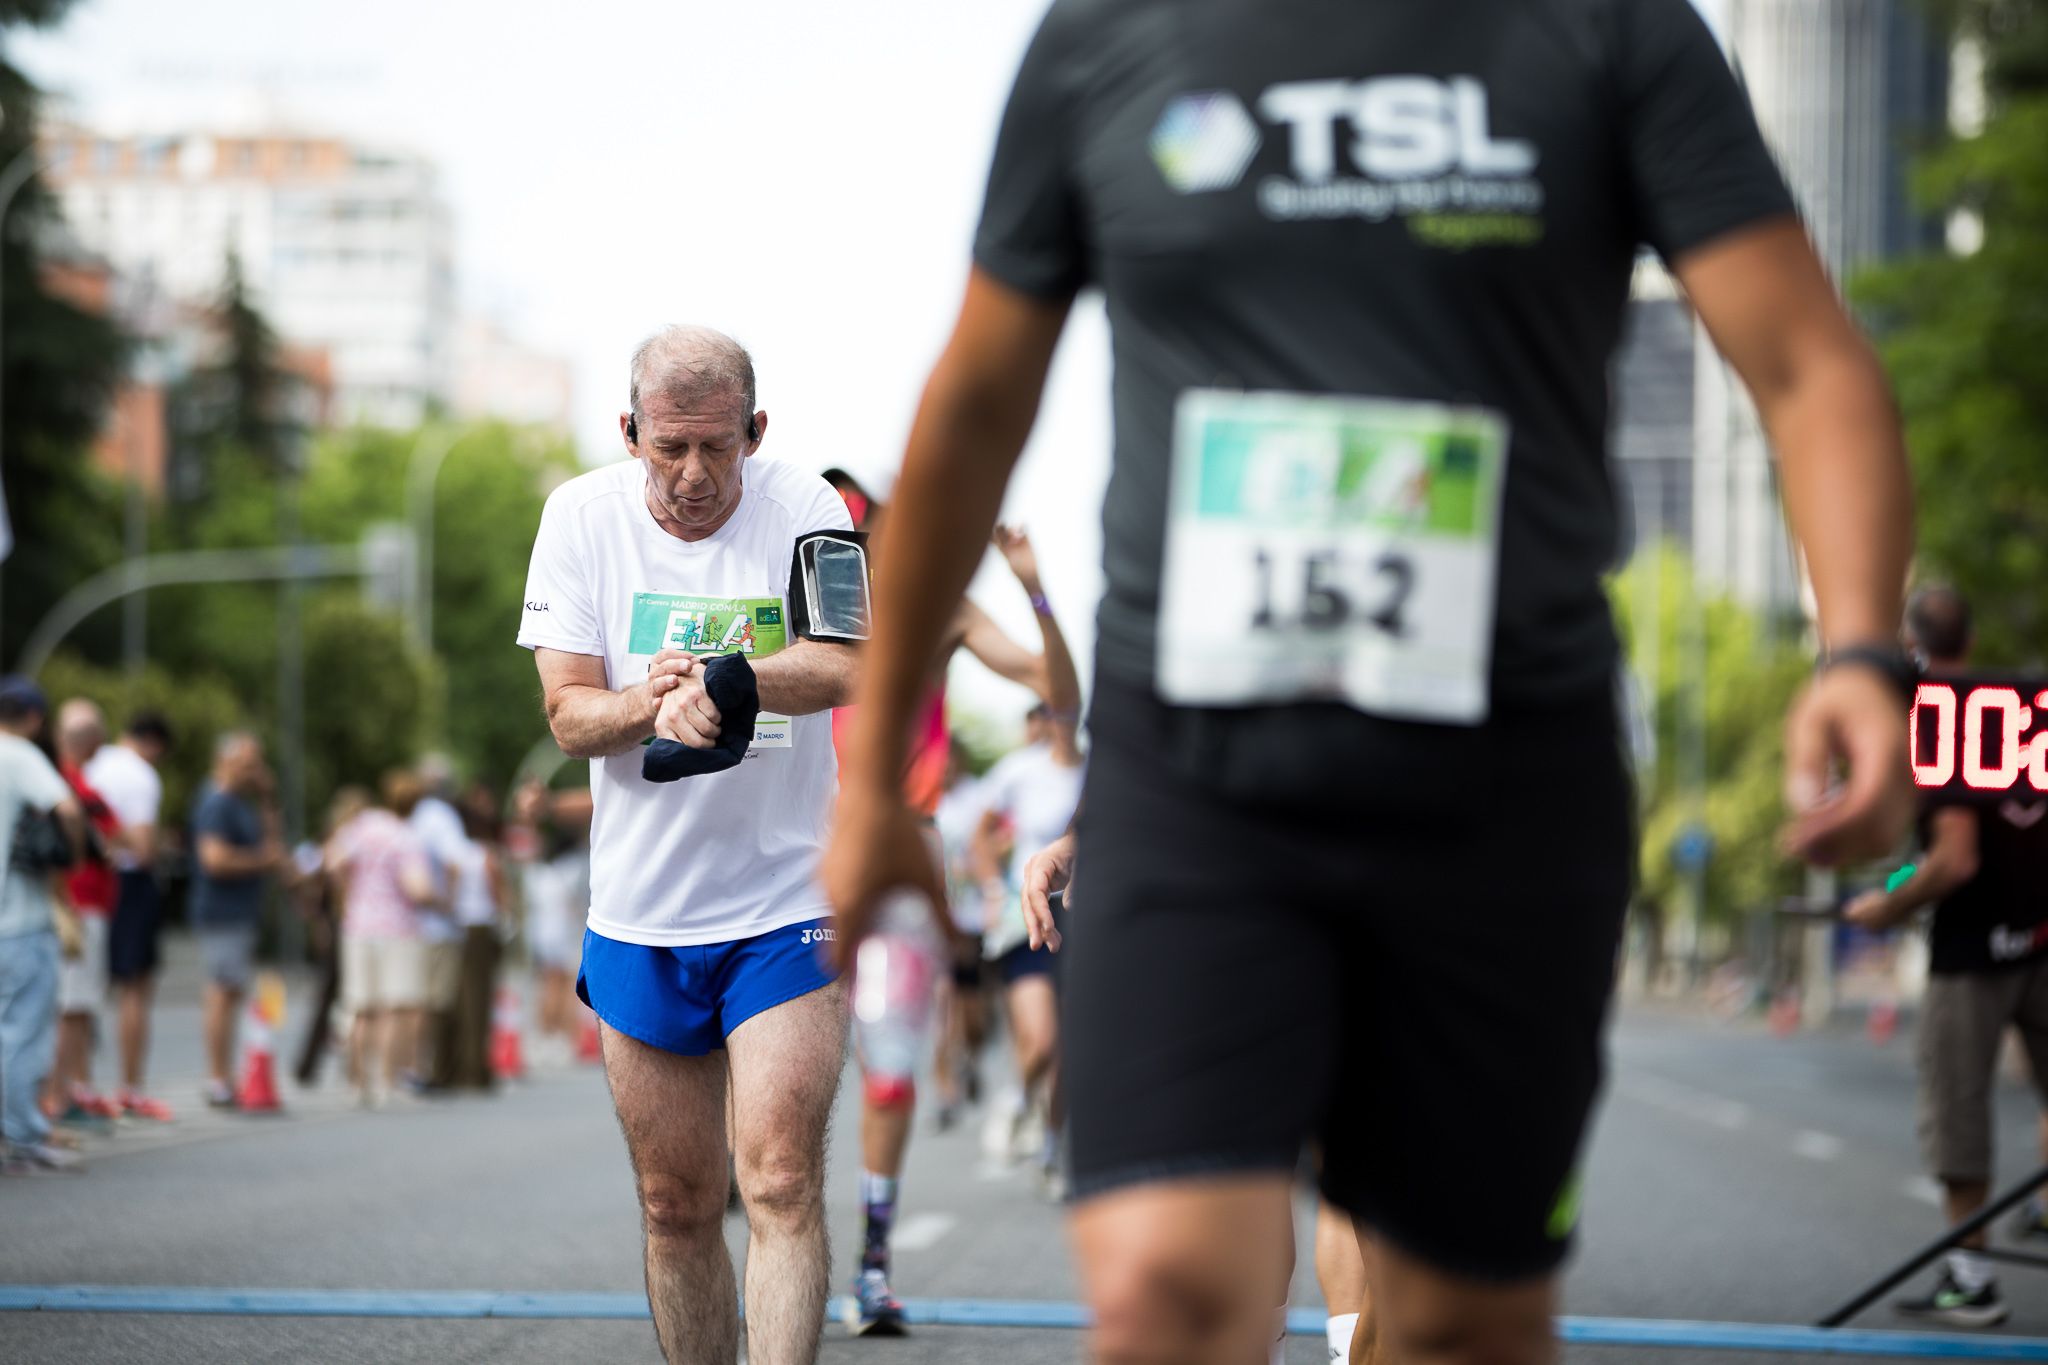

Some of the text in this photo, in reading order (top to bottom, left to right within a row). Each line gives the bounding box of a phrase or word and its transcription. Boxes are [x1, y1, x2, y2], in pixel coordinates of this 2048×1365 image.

[1260, 76, 1535, 180] TSL
[661, 609, 755, 654] ELA
[671, 599, 709, 611] MADRID
[709, 602, 732, 612] CON
[734, 603, 747, 613] LA
[1252, 549, 1416, 645] 152
[1909, 683, 2048, 791] 00:
